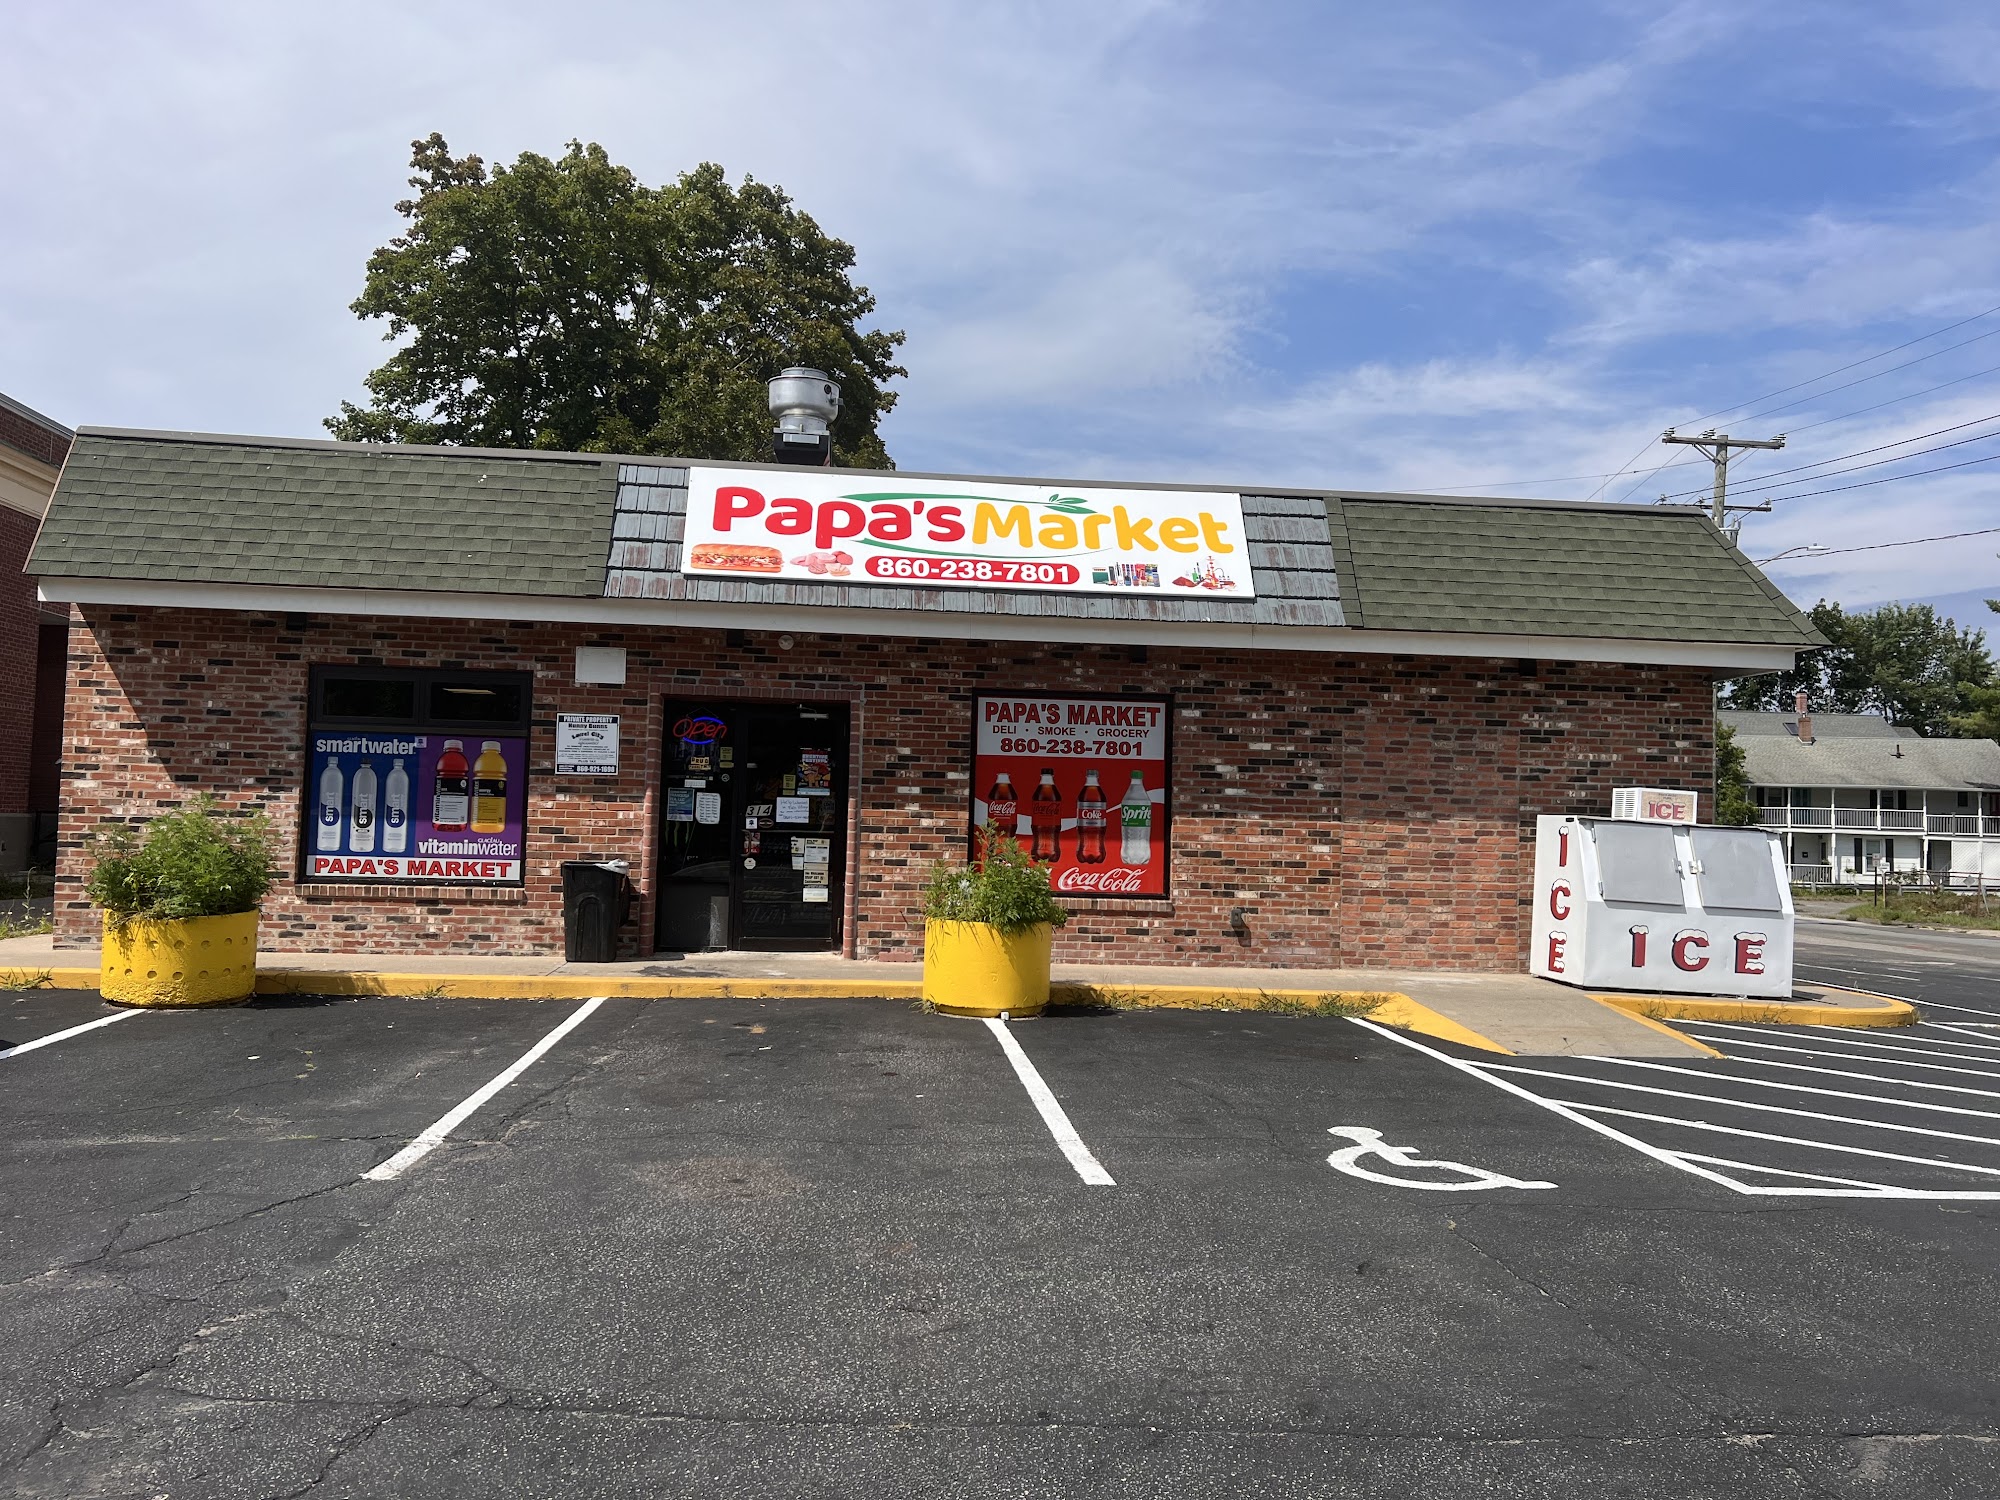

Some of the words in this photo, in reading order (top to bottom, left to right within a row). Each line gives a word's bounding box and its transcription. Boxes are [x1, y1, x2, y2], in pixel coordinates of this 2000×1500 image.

[713, 487, 966, 548] Papa's
[972, 502, 1234, 554] Market
[876, 559, 1071, 583] 860-238-7801
[985, 702, 1060, 724] PAPA'S
[1068, 705, 1161, 727] MARKET
[672, 718, 728, 738] Open
[992, 725, 1017, 734] DELI
[1038, 726, 1076, 736] SMOKE
[1097, 728, 1150, 738] GROCERY
[316, 737, 416, 754] smartwater
[1000, 738, 1142, 756] 860-238-7801
[325, 792, 335, 822] smart
[359, 793, 368, 824] smart
[391, 794, 400, 824] smart
[747, 806, 771, 815] 314
[989, 801, 1017, 815] Coca-Cola
[1081, 808, 1102, 819] Coke
[1648, 800, 1686, 820] ICE
[418, 839, 517, 856] vitaminwater
[315, 858, 399, 875] PAPA'S
[407, 860, 512, 878] MARKET
[1058, 867, 1147, 891] Coca-Cola
[1548, 826, 1571, 973] ICE
[1628, 924, 1767, 975] ICE
